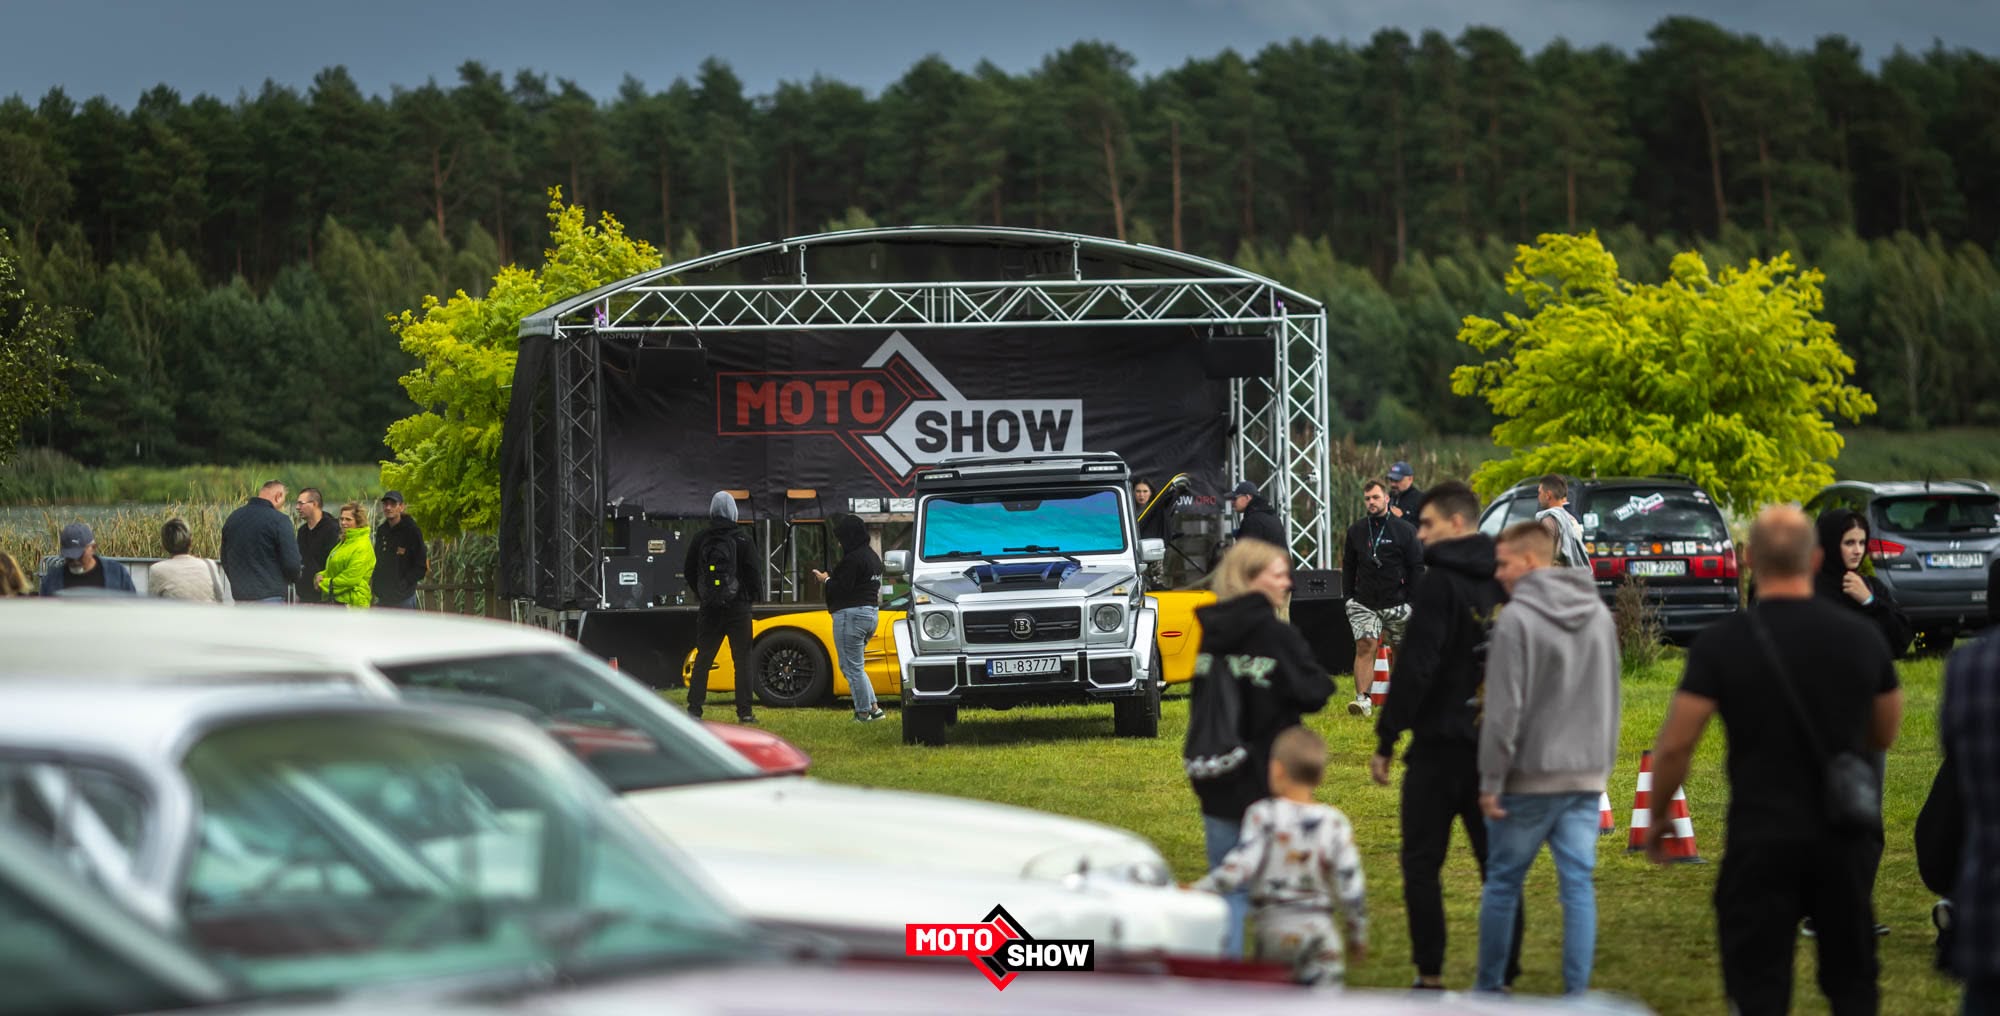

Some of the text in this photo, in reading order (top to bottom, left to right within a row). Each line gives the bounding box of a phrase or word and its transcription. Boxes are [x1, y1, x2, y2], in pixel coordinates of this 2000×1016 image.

[736, 380, 886, 426] MOTO
[915, 409, 1074, 454] SHOW
[995, 658, 1057, 674] BL 83777
